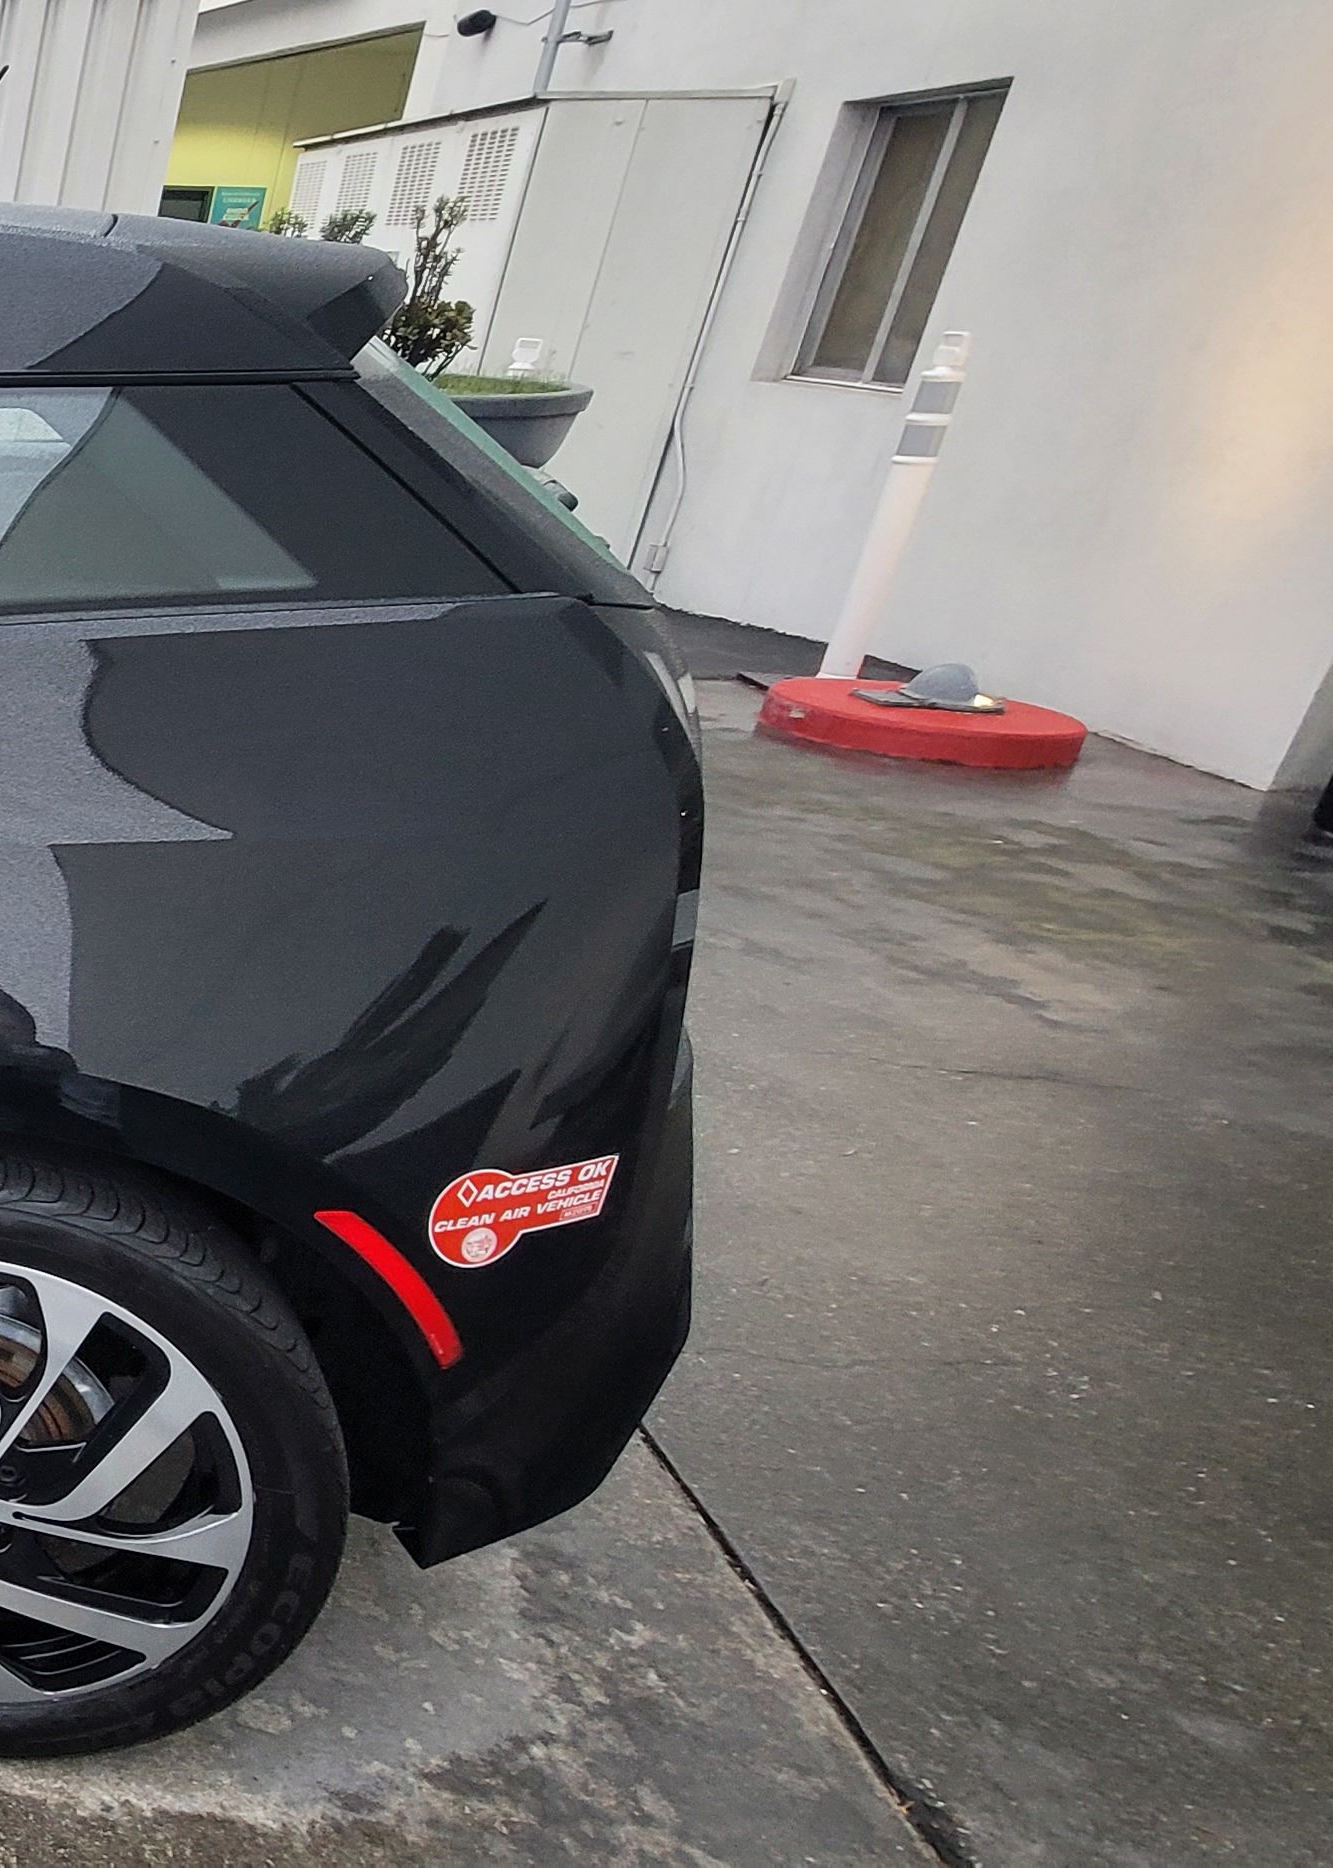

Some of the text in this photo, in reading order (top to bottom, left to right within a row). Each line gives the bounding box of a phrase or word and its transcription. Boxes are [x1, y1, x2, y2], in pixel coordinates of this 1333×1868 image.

[476, 1160, 609, 1202] ACCESS OK
[434, 1208, 495, 1233] CLEAN
[499, 1205, 531, 1223] AIR
[536, 1189, 603, 1215] VEHICLE
